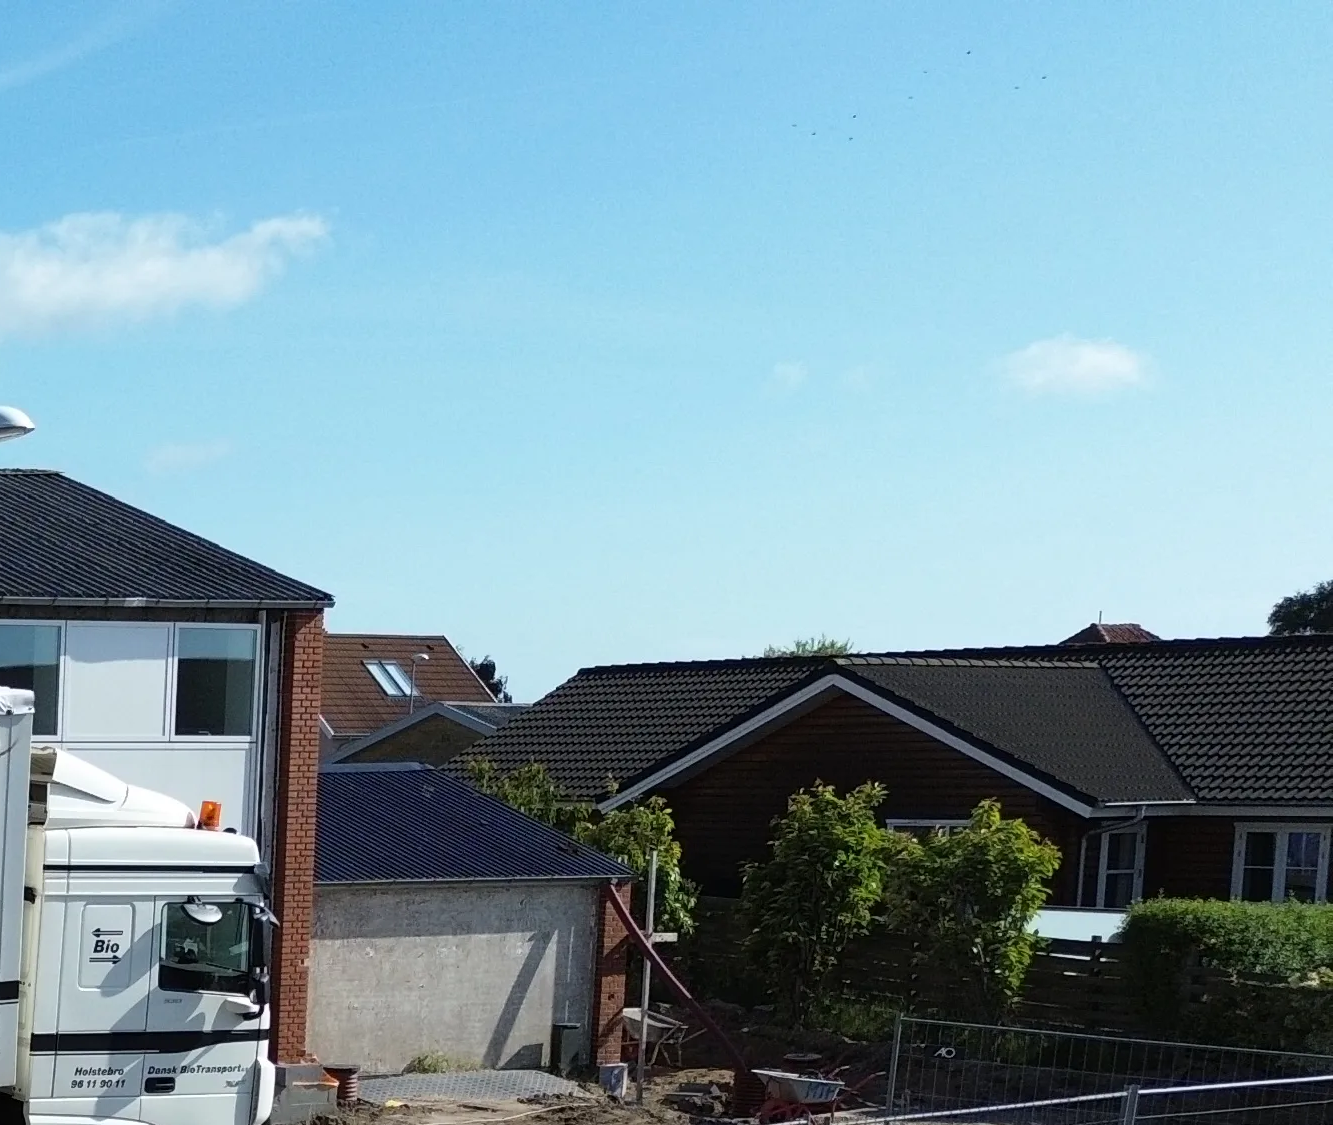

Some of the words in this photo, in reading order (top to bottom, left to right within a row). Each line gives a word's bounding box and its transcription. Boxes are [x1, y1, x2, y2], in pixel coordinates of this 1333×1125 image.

[93, 939, 120, 954] Bio
[74, 1066, 124, 1077] Holstebro
[147, 1065, 178, 1075] Dansk
[180, 1064, 242, 1075] BioTransport
[86, 1079, 97, 1089] 11
[100, 1078, 113, 1088] 90
[115, 1078, 126, 1088] 11
